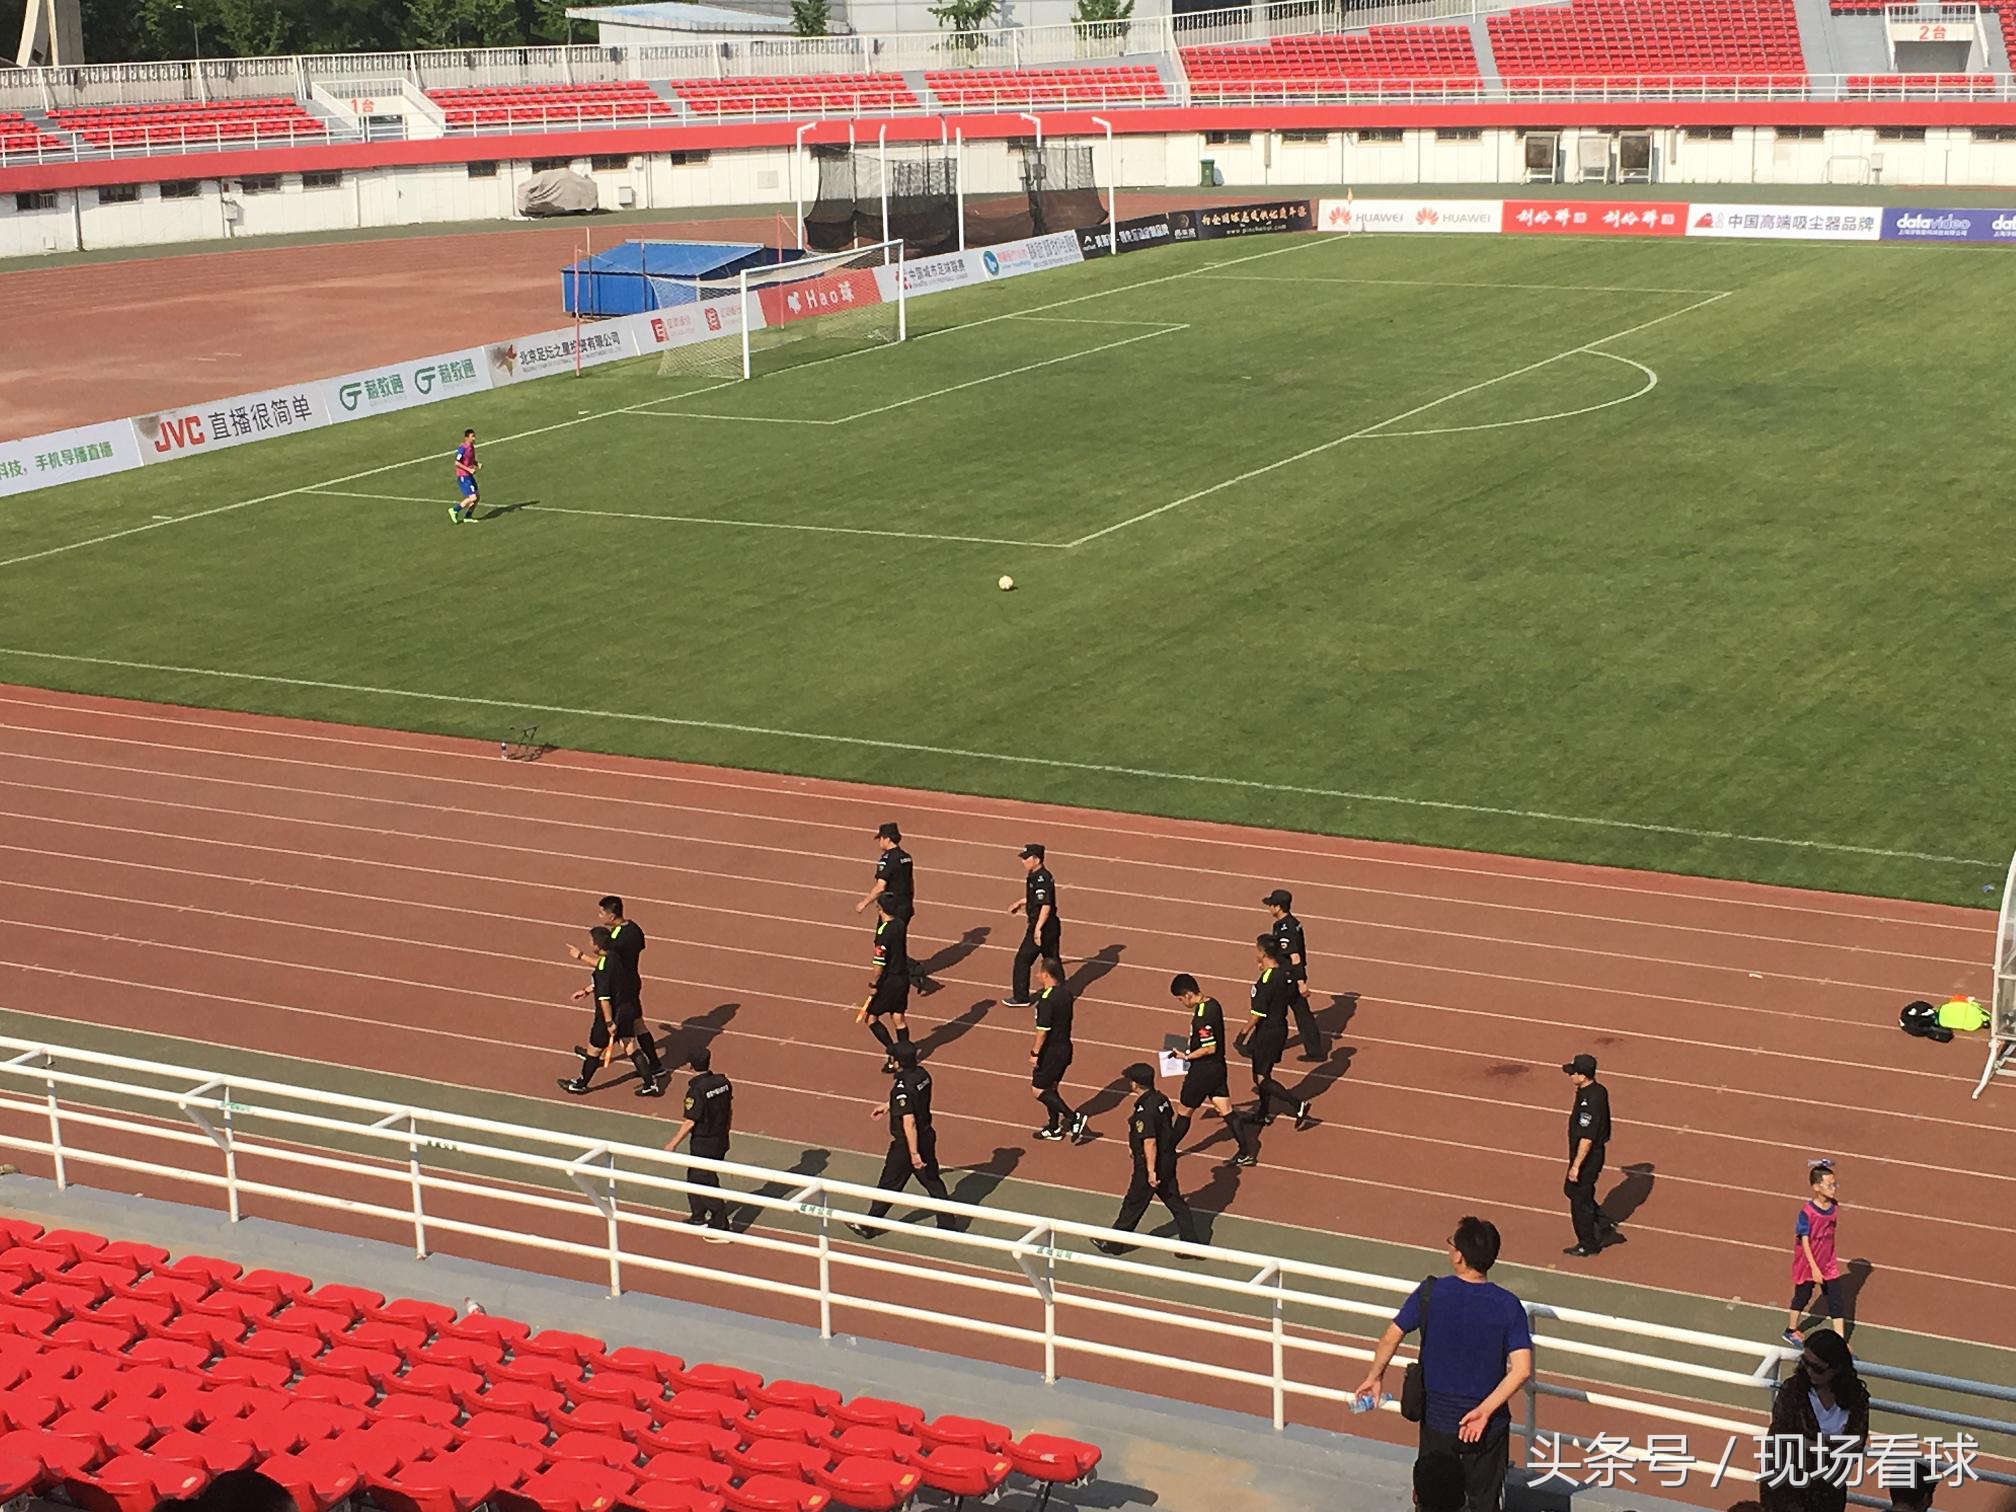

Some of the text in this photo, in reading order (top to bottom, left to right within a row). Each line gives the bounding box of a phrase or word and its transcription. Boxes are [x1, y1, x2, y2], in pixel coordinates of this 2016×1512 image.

[1920, 25, 1946, 40] 2台
[351, 98, 374, 114] 1台
[1355, 213, 1403, 223] HUAWEI
[1442, 213, 1490, 223] HUAWEI
[1728, 213, 1875, 232] 中国高端吸尘器品牌
[1896, 213, 1971, 230] datavideo
[154, 394, 312, 453] JVC 直播很简单
